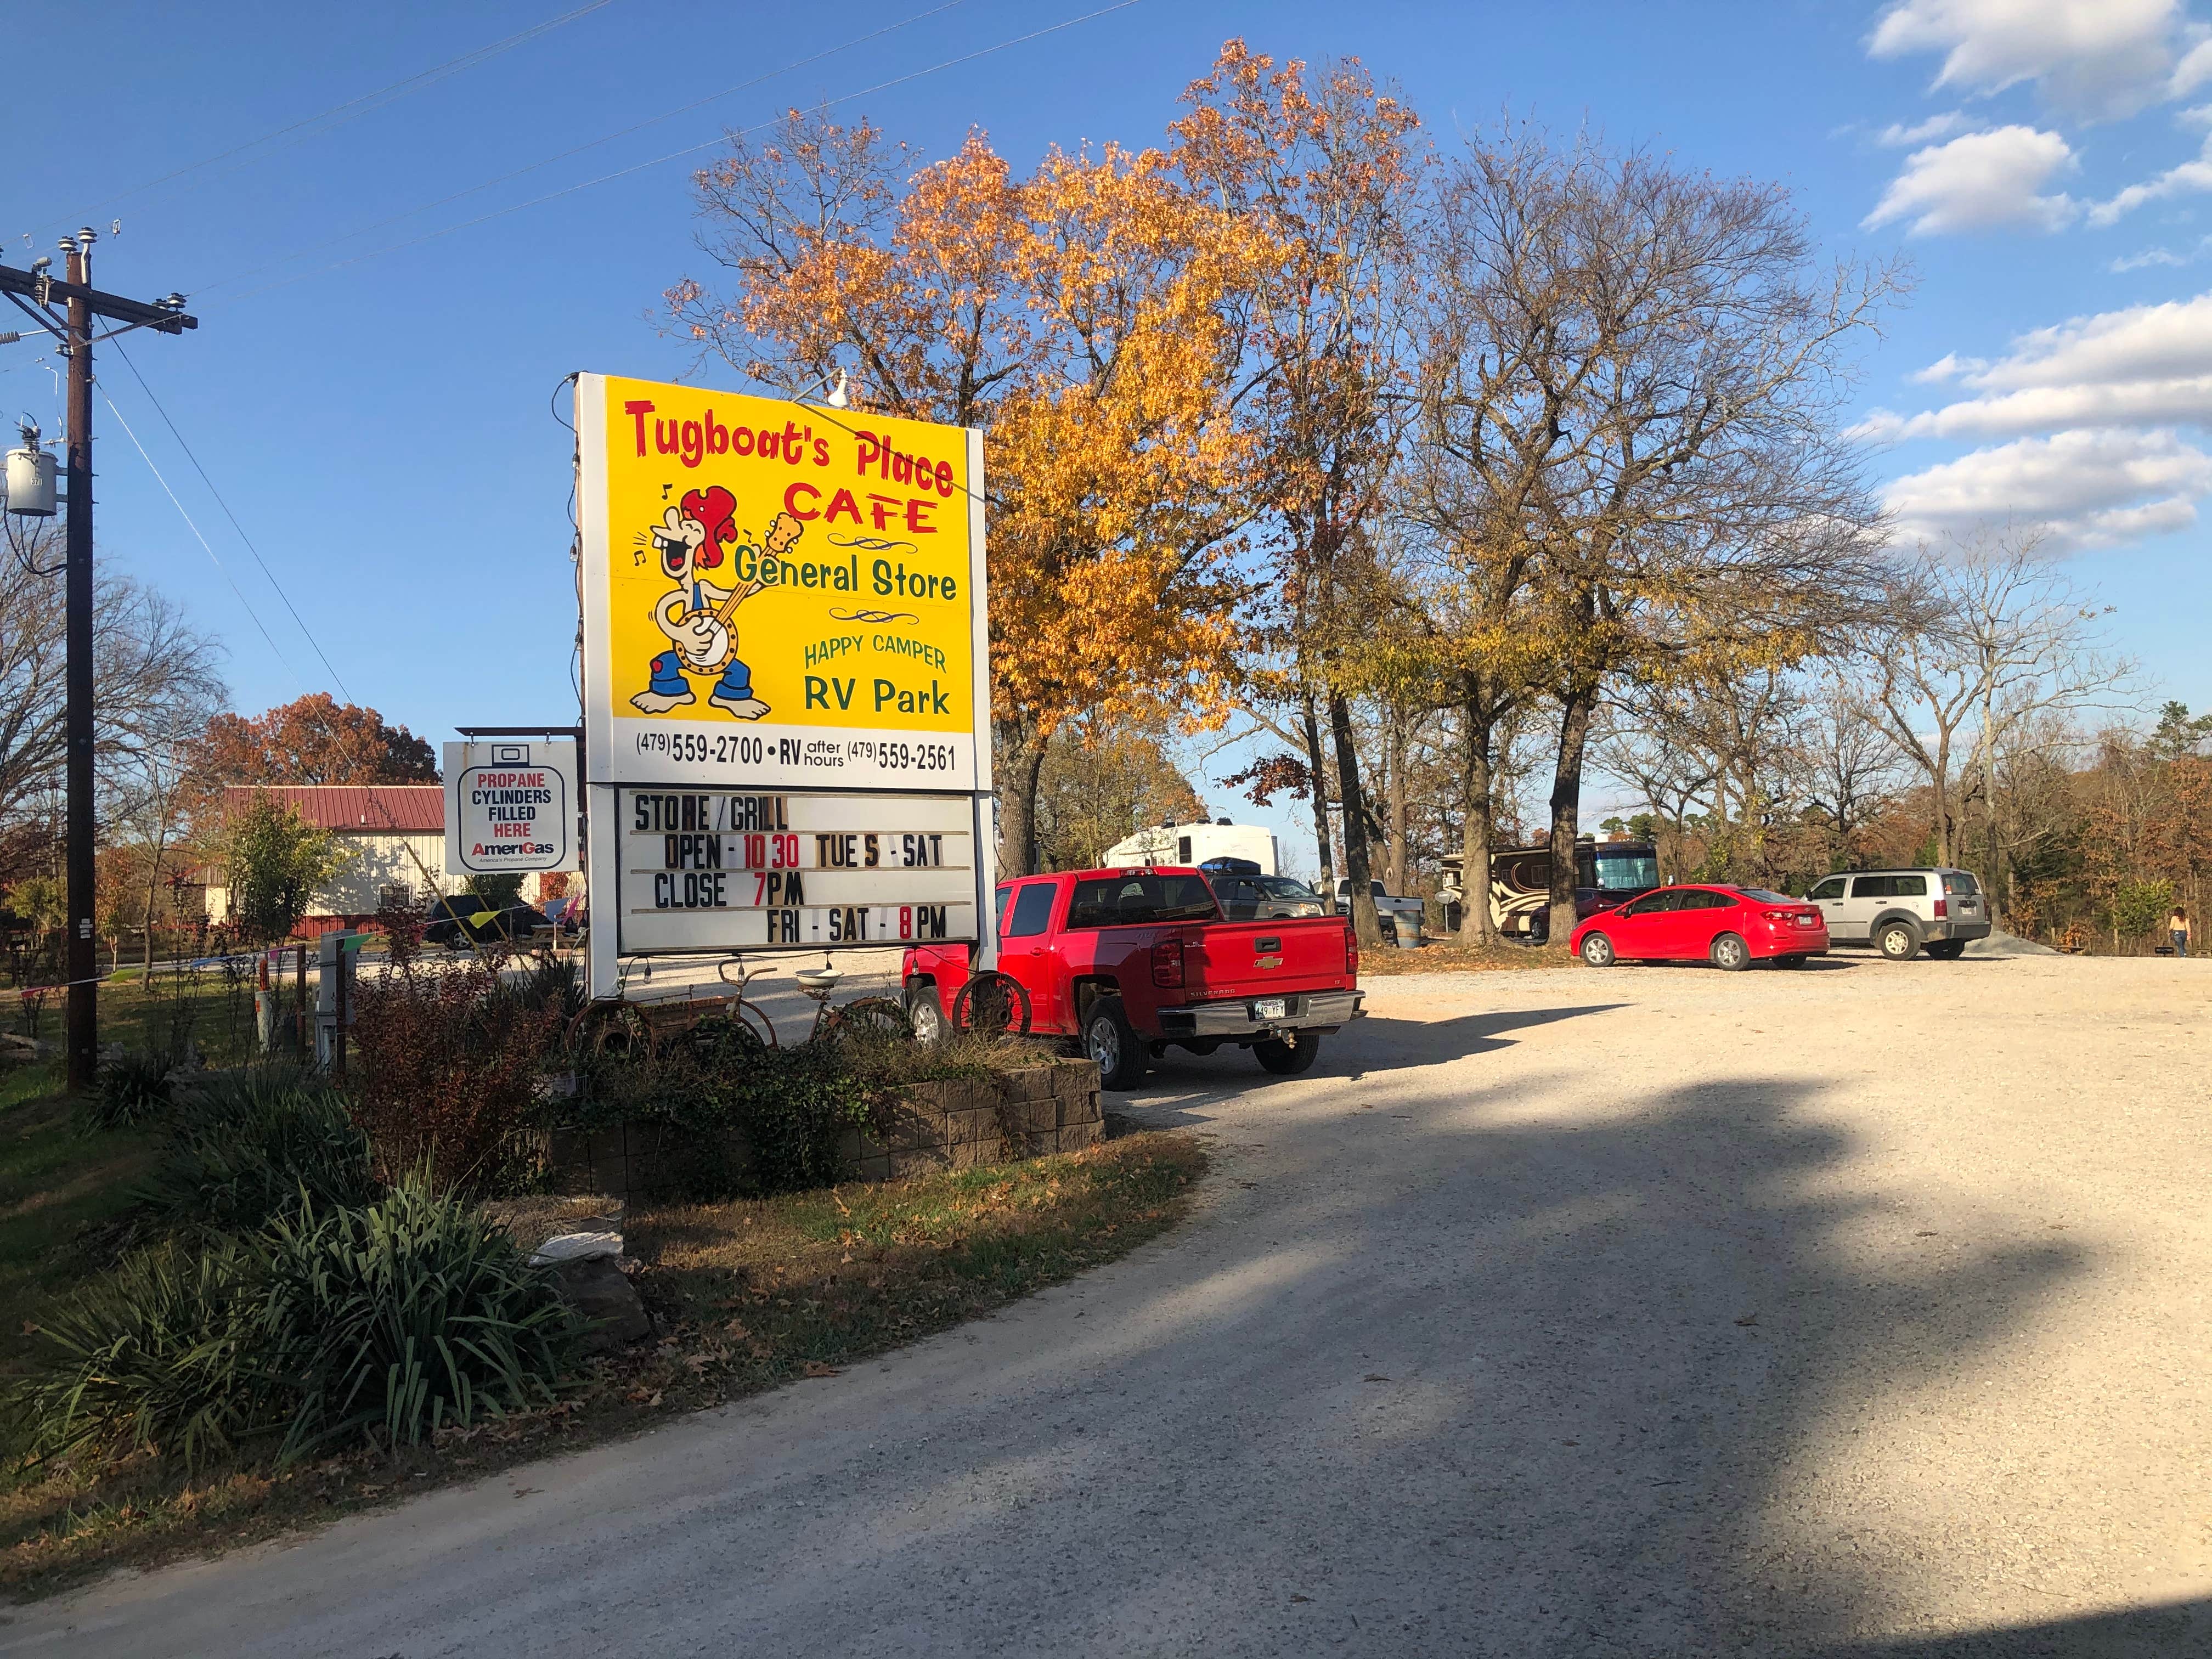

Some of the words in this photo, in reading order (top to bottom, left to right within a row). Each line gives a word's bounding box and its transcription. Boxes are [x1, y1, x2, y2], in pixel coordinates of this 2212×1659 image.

[624, 400, 830, 468] Tugboat's
[854, 431, 953, 498] Place
[784, 482, 938, 533] CAFE
[735, 545, 858, 591] General
[872, 558, 957, 601] Store
[804, 634, 864, 669] HAPPY
[873, 634, 947, 674] CAMPER
[804, 675, 856, 710] RV
[873, 678, 950, 714] Park
[780, 738, 801, 765] RV
[804, 753, 844, 767] hours
[806, 741, 841, 754] after
[478, 773, 545, 788] PROPANE
[472, 789, 551, 805] CYLINDERS
[488, 806, 536, 821] FILLED
[731, 797, 788, 831] GRILL
[494, 823, 531, 838] HERE
[471, 842, 554, 856] AmeriGas
[665, 834, 721, 869] OPEN
[903, 834, 943, 867] SAT
[654, 873, 727, 909] CLOSE
[768, 910, 800, 943] FRI
[829, 907, 869, 941] SAT
[1190, 988, 1235, 997] SILVERADO
